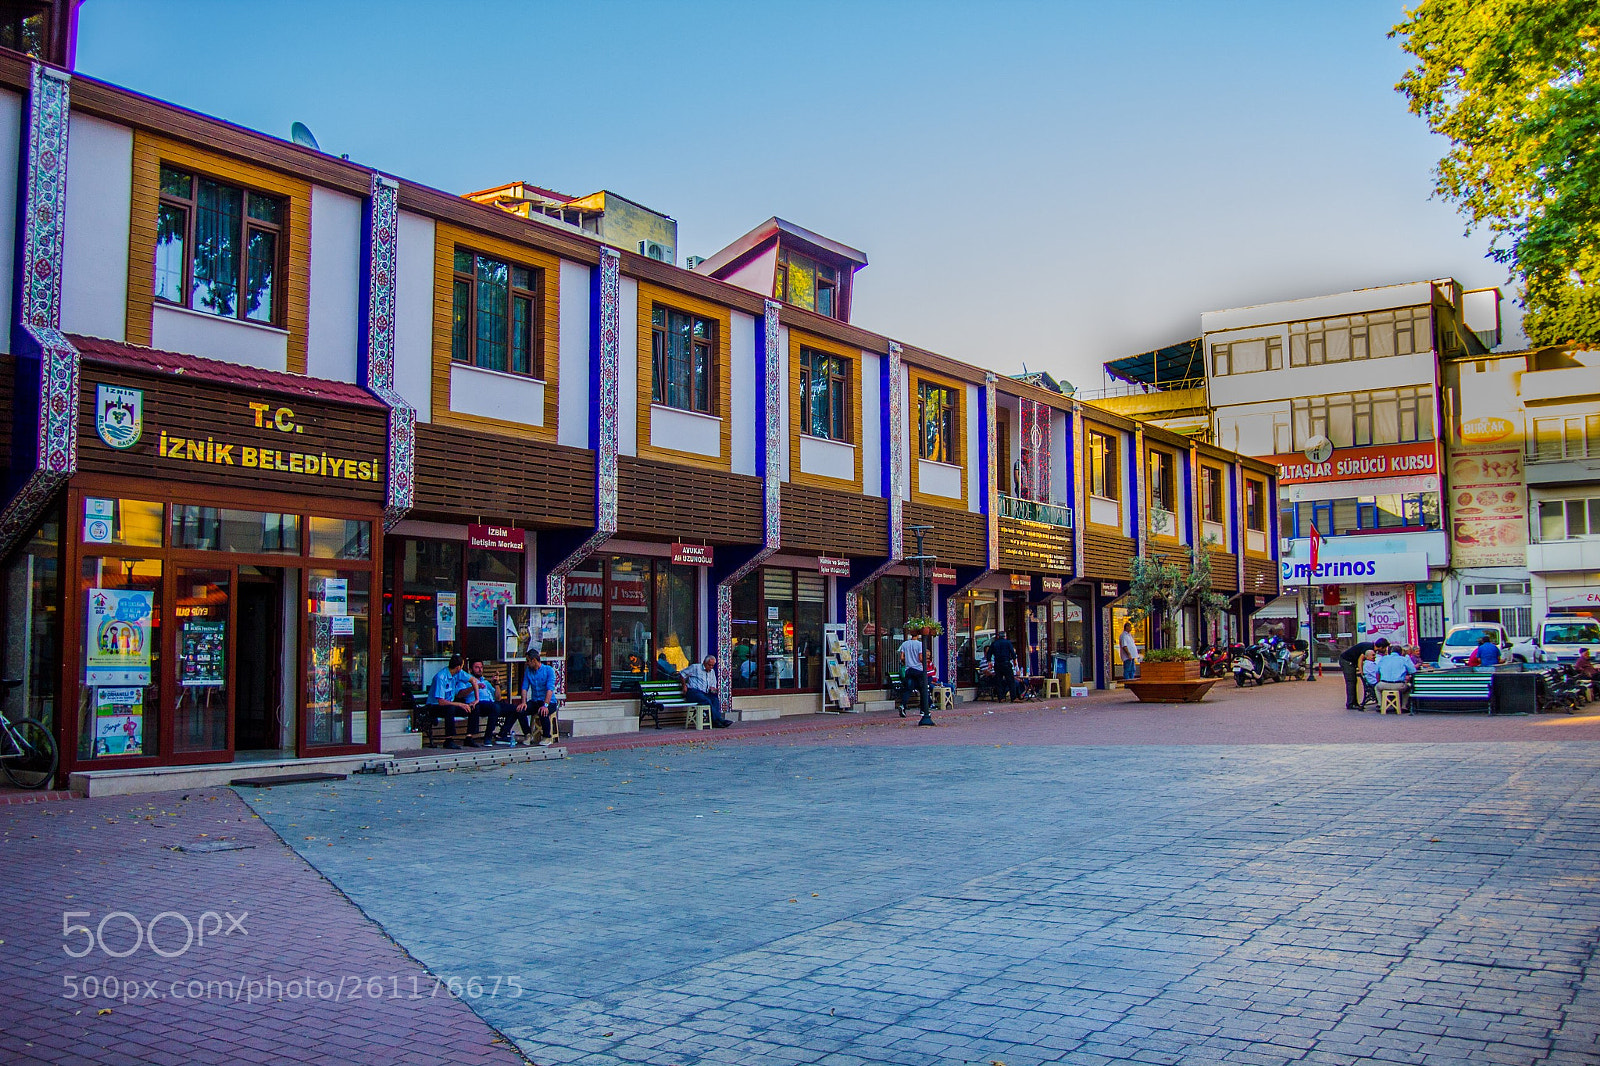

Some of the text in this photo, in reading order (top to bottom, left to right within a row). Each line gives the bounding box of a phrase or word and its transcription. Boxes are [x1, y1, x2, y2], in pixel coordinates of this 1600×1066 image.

[249, 401, 304, 433] T.C.
[1464, 421, 1505, 434] BURÇAK
[159, 430, 378, 482] İZNİK BELEDİYESİ
[1336, 455, 1386, 476] SÜRÜCÜ
[1391, 453, 1434, 471] KURSU
[488, 527, 508, 537] İZBİM
[471, 537, 497, 548] İletişim
[682, 546, 705, 555] AVUKAT
[1294, 560, 1376, 578] merinos
[1372, 615, 1389, 623] 100
